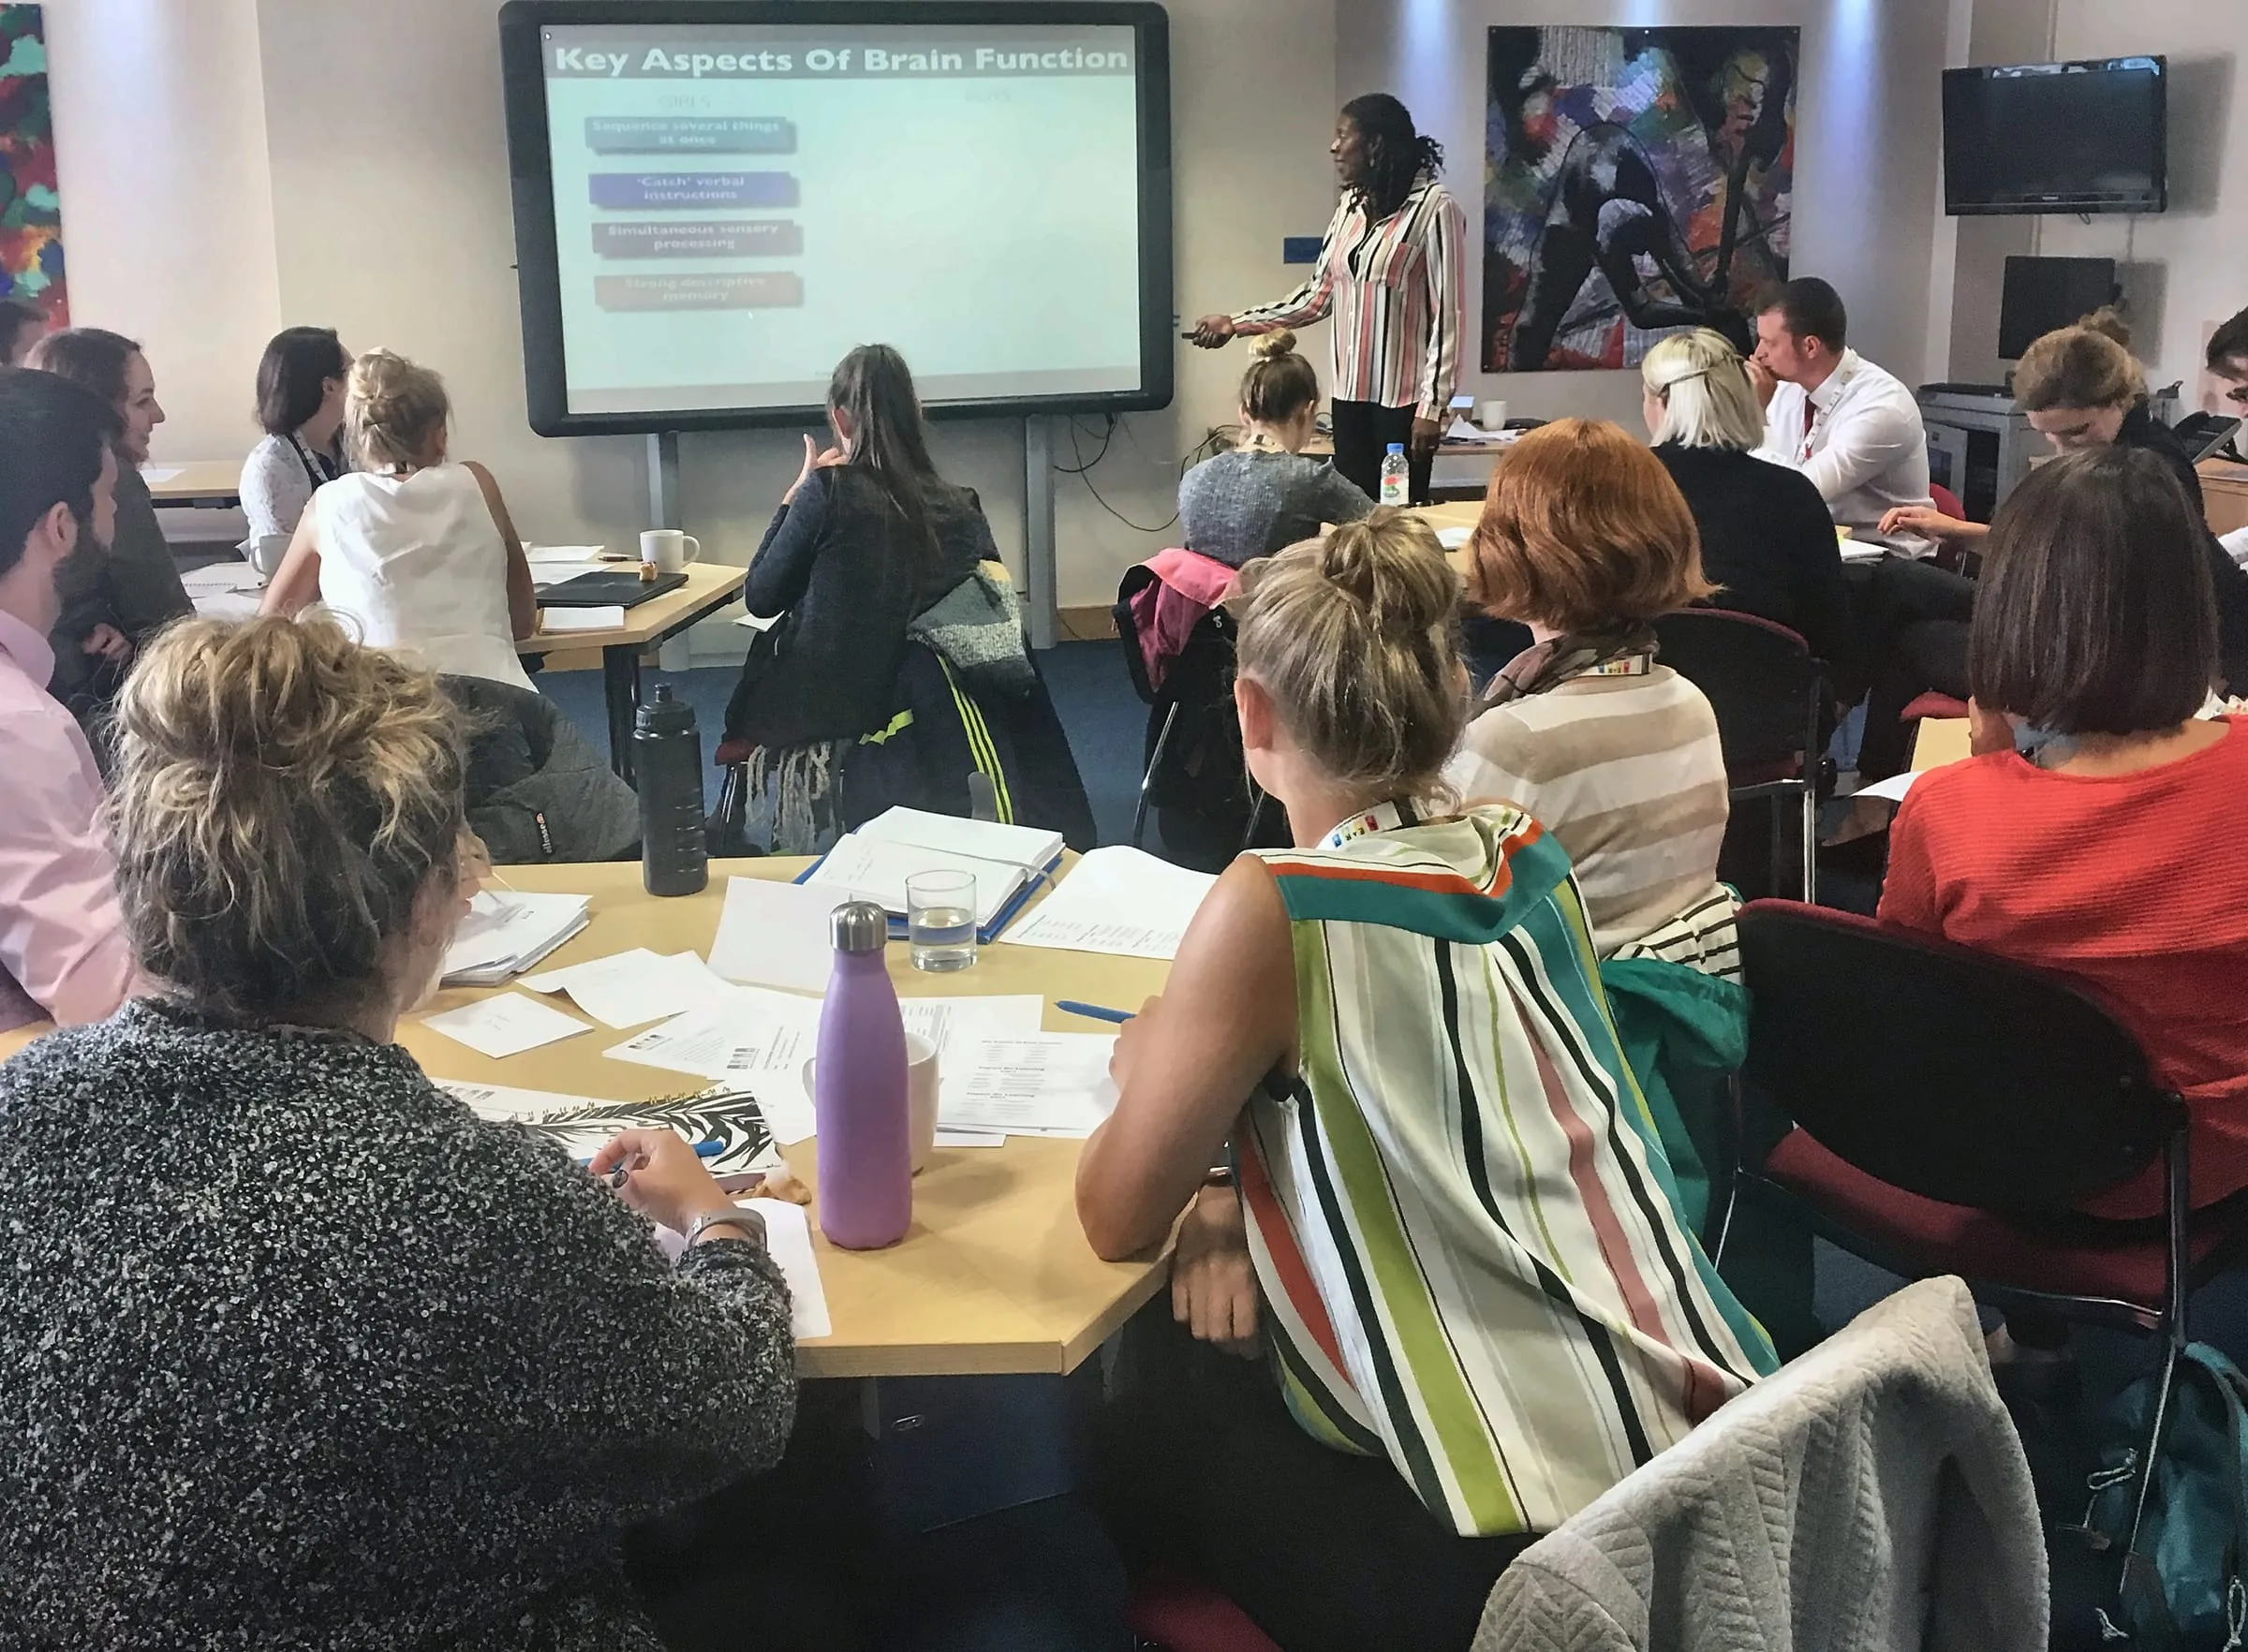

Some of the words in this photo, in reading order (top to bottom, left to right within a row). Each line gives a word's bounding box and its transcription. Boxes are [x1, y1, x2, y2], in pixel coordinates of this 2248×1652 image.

[556, 48, 629, 77] Key
[642, 48, 791, 77] Aspects
[806, 48, 850, 71] Of
[865, 49, 962, 71] Brain
[976, 48, 1127, 70] Function
[732, 120, 779, 133] things
[696, 176, 745, 187] verbal
[644, 190, 738, 200] instructions
[608, 225, 714, 236] Simultaneous
[719, 224, 779, 236] sensory
[654, 238, 735, 251] processing
[663, 290, 729, 302] memory
